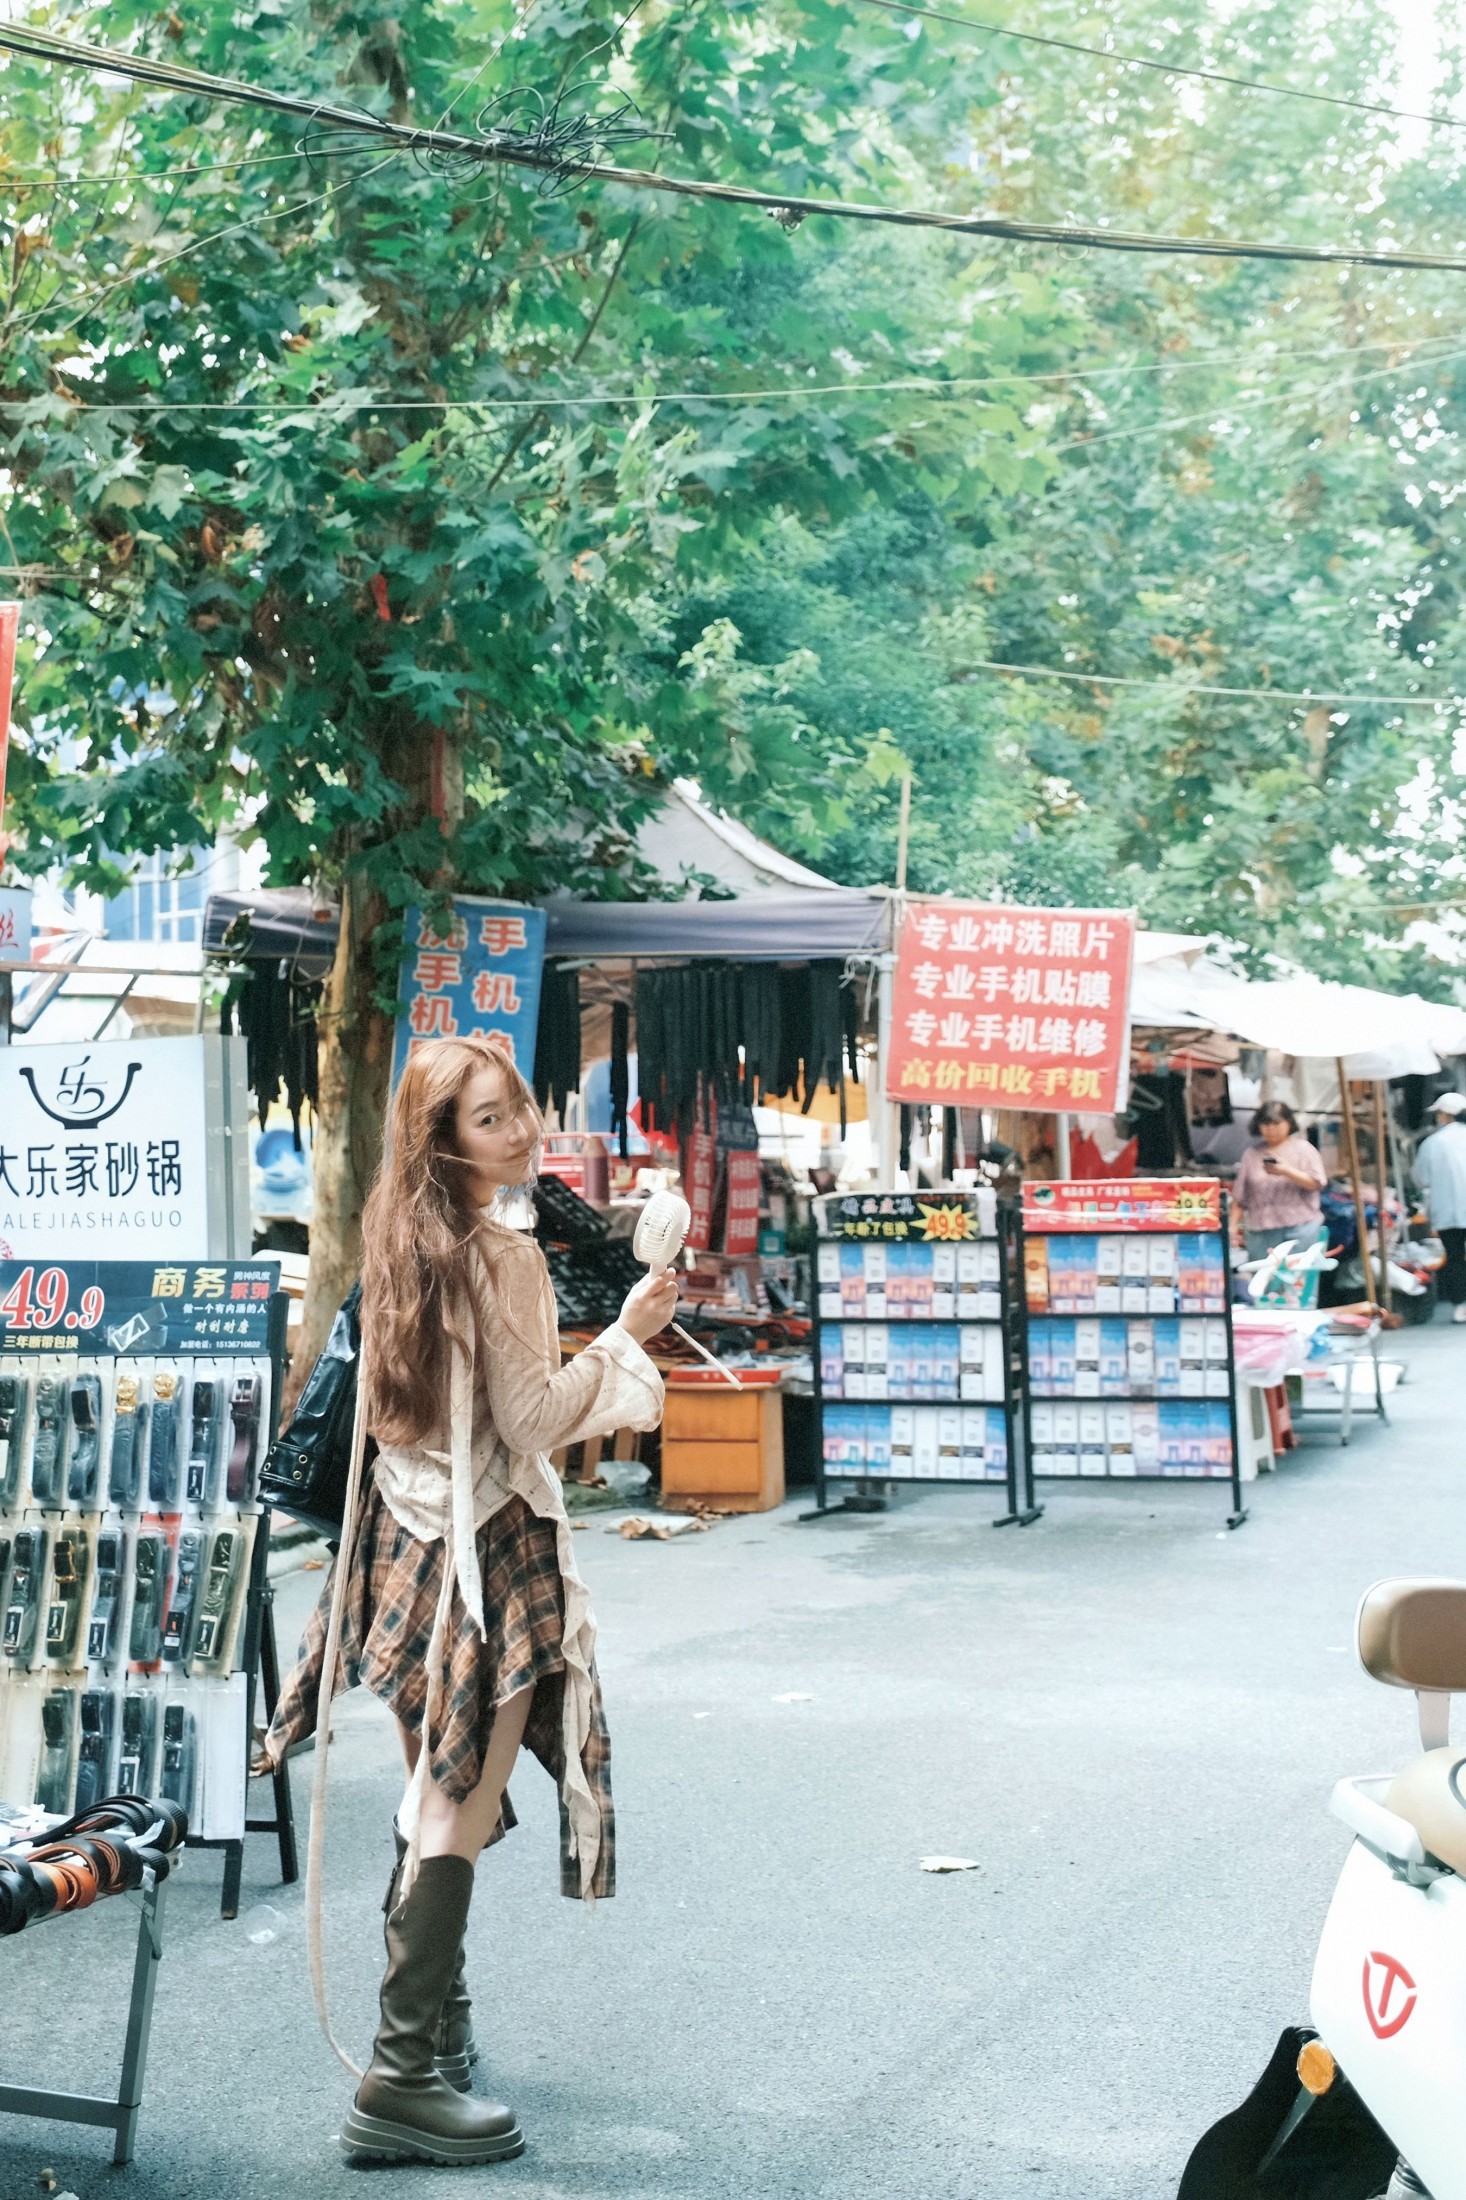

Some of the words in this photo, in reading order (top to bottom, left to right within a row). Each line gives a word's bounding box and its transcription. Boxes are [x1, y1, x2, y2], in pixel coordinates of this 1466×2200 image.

[914, 914, 1114, 960] 专业冲洗照片
[909, 961, 1113, 1009] 专业手机贴膜
[904, 1009, 1108, 1057] 专业手机维修
[900, 1058, 1103, 1100] 高价回收手机
[926, 1212, 967, 1237] 49.9
[0, 1266, 105, 1329] 49.9
[151, 1267, 228, 1299] 商务
[230, 1282, 270, 1300] 系列
[183, 1303, 267, 1314] 做一个有内涵的人
